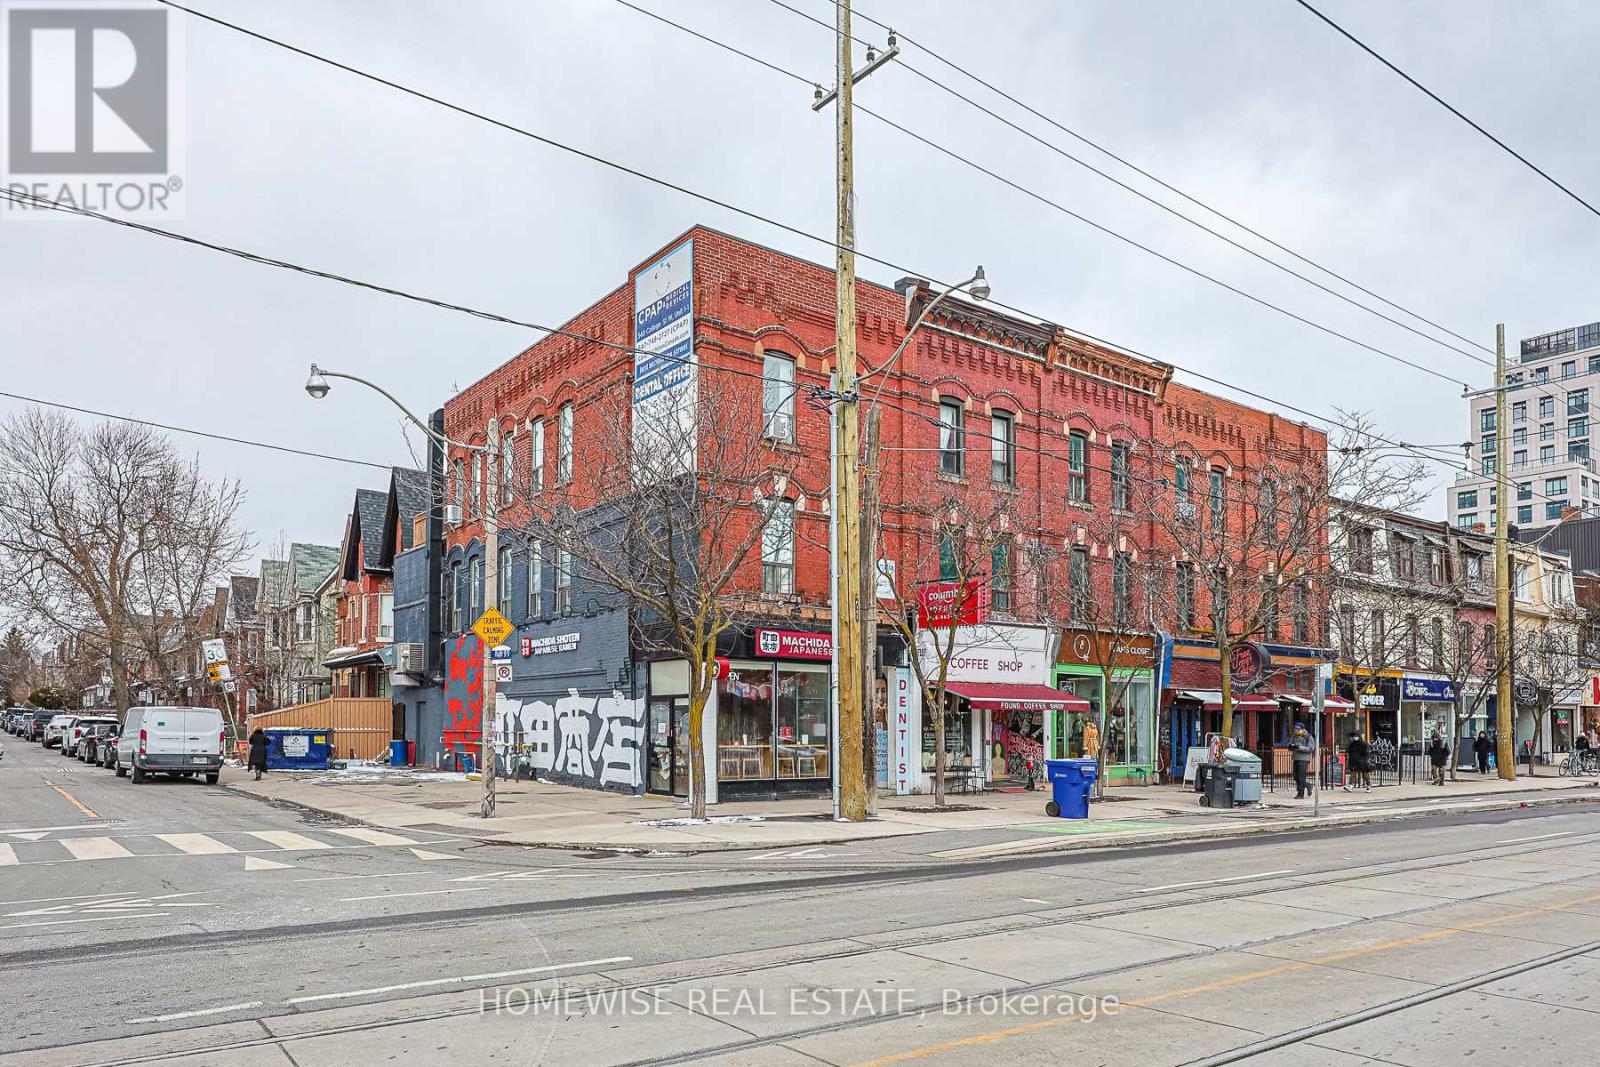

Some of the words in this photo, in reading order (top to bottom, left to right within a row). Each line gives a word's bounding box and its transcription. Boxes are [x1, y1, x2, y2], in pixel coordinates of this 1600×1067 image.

[638, 299, 663, 324] CPAP
[483, 617, 503, 625] TRAFFIC
[483, 626, 504, 634] CALMING
[556, 633, 581, 644] SHOTEN
[782, 636, 831, 648] MACHIDA
[534, 645, 559, 655] JAPANESE
[558, 642, 577, 652] RAMEN
[950, 657, 988, 670] COFFEE
[997, 660, 1023, 671] SHOP
[898, 679, 908, 792] DENTIST
